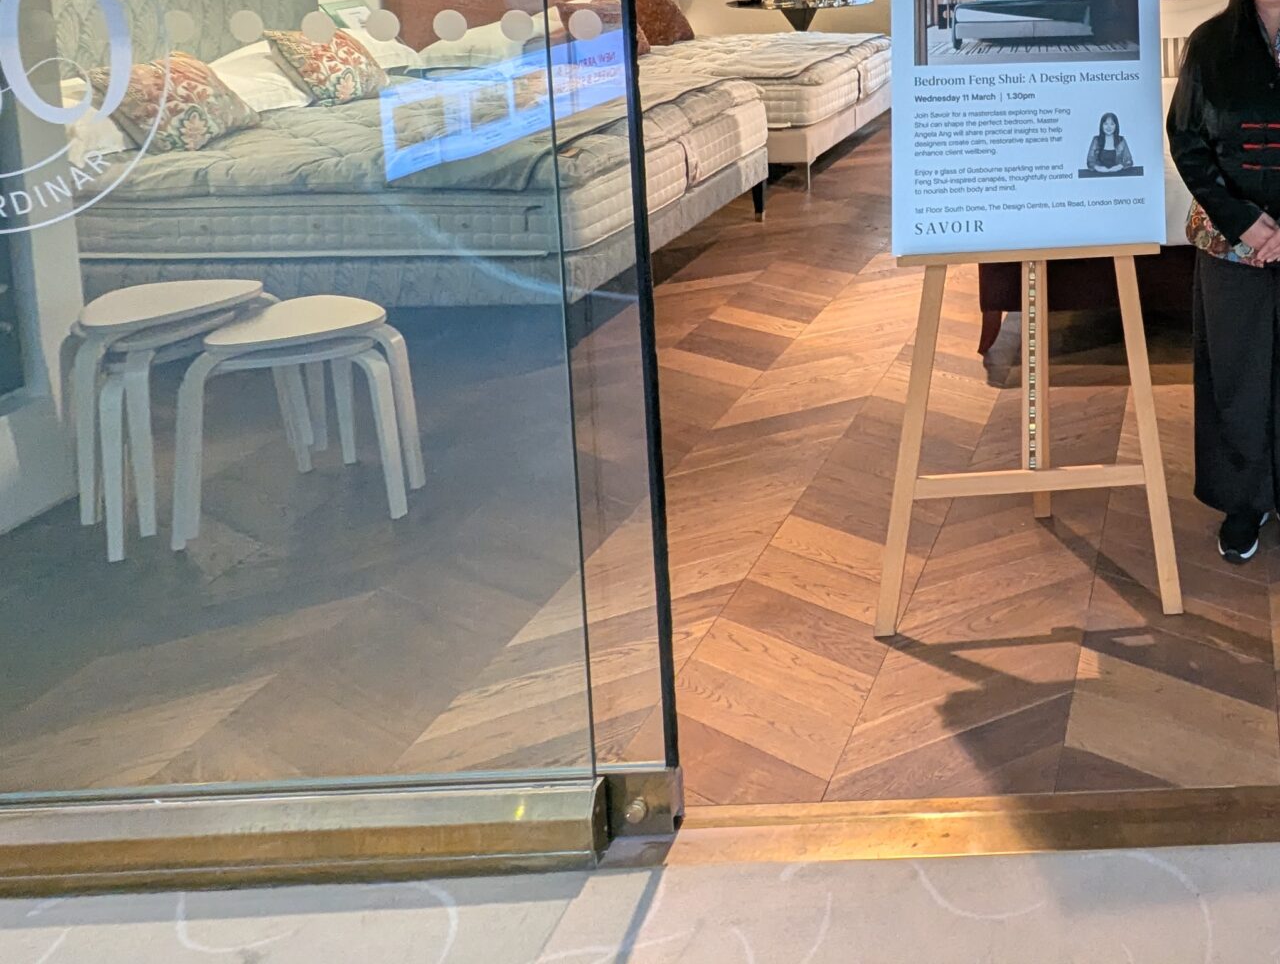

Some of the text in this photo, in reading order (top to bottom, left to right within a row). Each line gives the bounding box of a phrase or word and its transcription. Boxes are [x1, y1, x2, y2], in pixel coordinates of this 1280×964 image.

[914, 71, 1140, 86] Bedroom Feng Shui: A Design Masterclass
[915, 94, 960, 103] Wednesday
[972, 92, 996, 101] March
[1006, 92, 1035, 100] 1.30pm
[1008, 109, 1037, 117] exploring
[1055, 107, 1070, 116] Feng
[944, 120, 964, 128] shape
[979, 119, 1002, 127] perfect
[985, 128, 1012, 136] practical
[1014, 127, 1038, 135] insights
[990, 137, 1023, 145] restorative
[915, 169, 932, 177] Enjoy
[940, 168, 957, 176] glass
[1004, 165, 1033, 173] sparkling
[934, 177, 976, 185] Shui-inspired
[1009, 174, 1047, 182] thoughtfully
[924, 187, 948, 195] nourish
[967, 186, 983, 194] body
[945, 205, 964, 213] South
[1003, 203, 1025, 211] Design
[1068, 200, 1086, 208] Road,
[1088, 199, 1112, 207] London
[914, 220, 984, 236] SAVOIR
